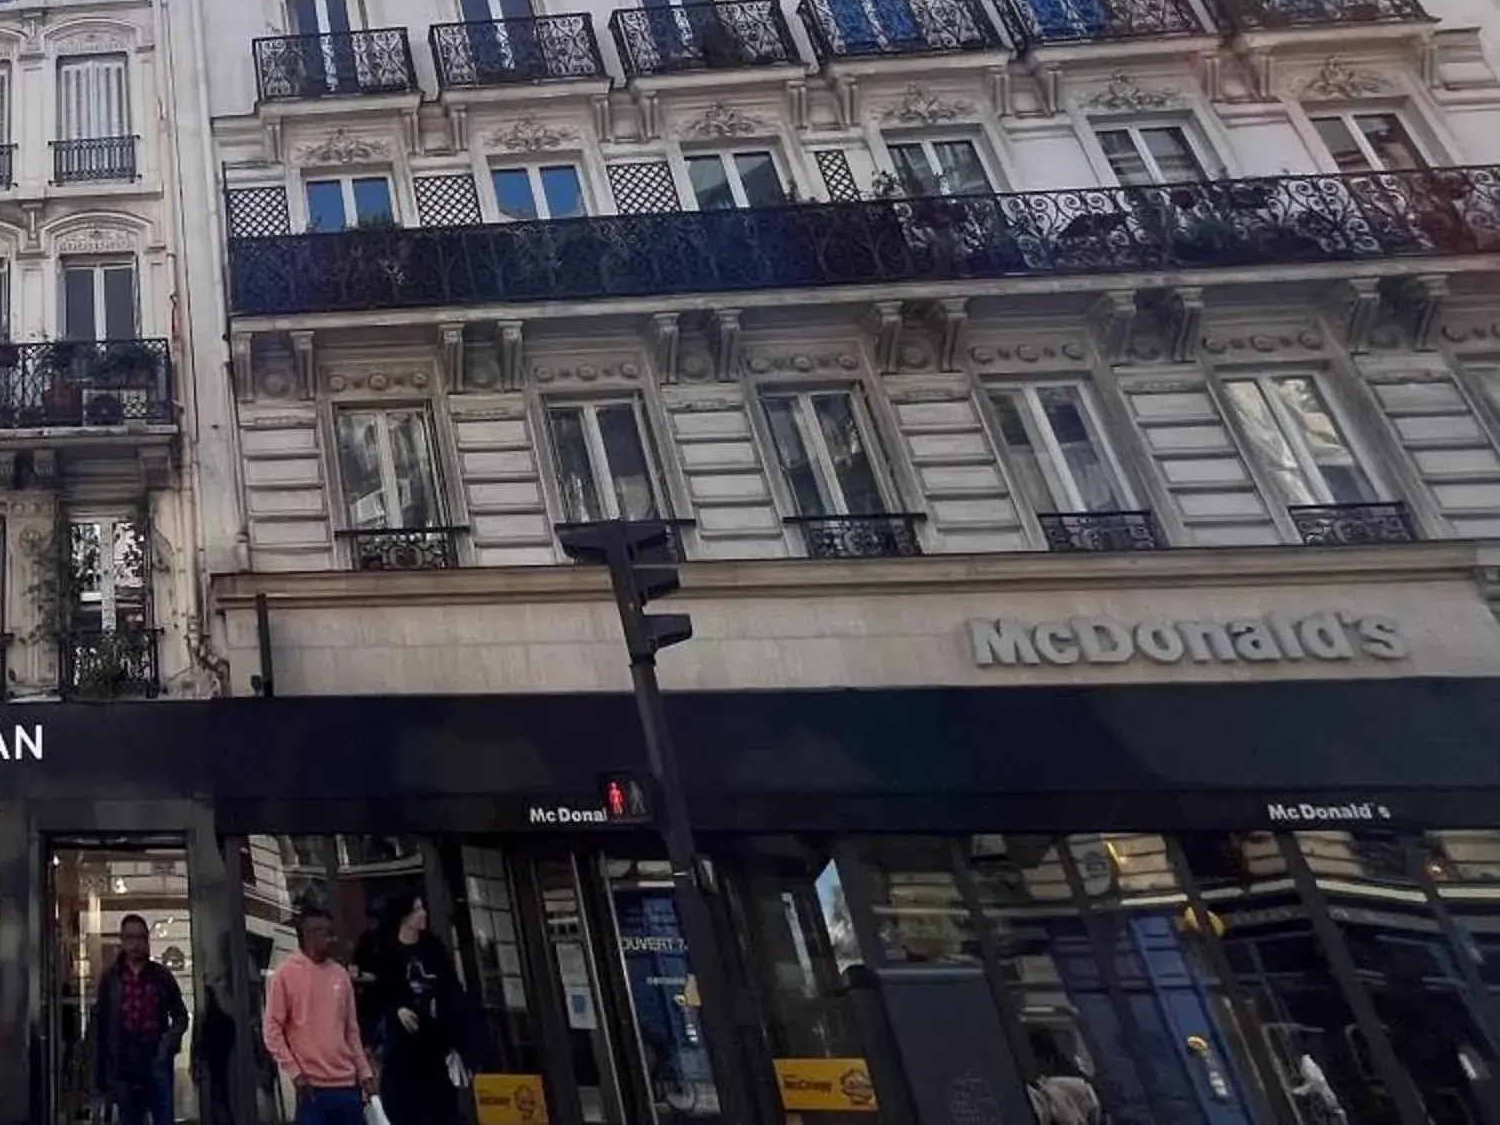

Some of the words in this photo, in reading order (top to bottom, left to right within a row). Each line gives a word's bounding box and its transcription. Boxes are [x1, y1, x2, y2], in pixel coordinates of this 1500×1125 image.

[967, 613, 1408, 666] McDonald's
[530, 806, 607, 823] McDonal
[1267, 802, 1391, 820] McDonald's
